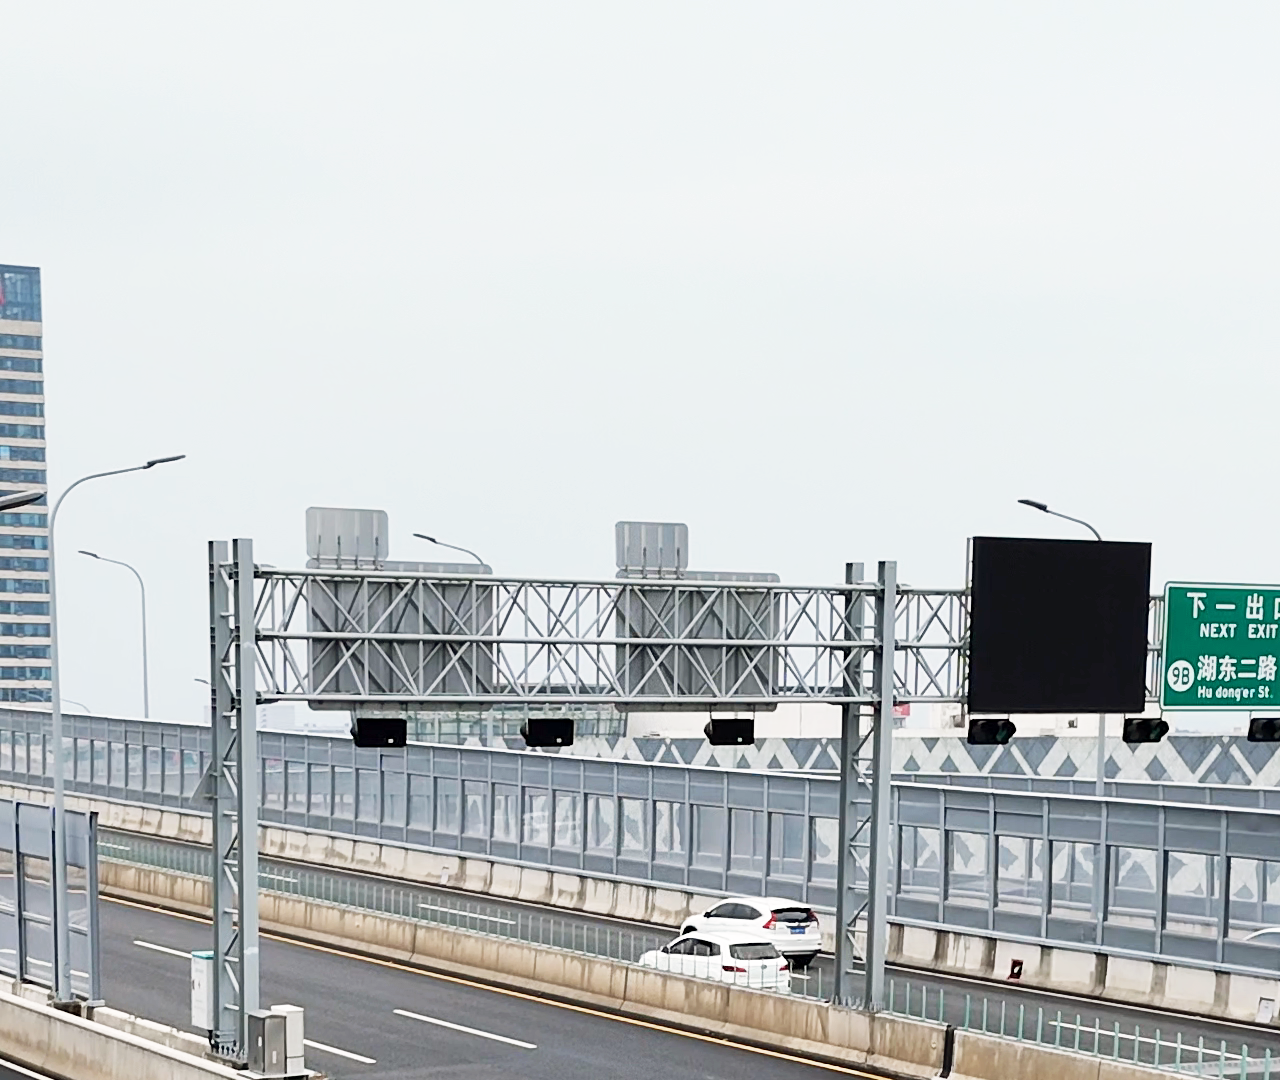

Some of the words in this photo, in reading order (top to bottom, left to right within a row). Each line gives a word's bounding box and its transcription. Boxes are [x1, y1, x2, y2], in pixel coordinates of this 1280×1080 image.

[1199, 623, 1237, 638] NEXT
[1248, 623, 1278, 639] EXIT
[1171, 666, 1191, 685] 9B
[1197, 654, 1278, 682] 湖东二路
[1197, 685, 1213, 698] Hu
[1258, 685, 1274, 698] St.
